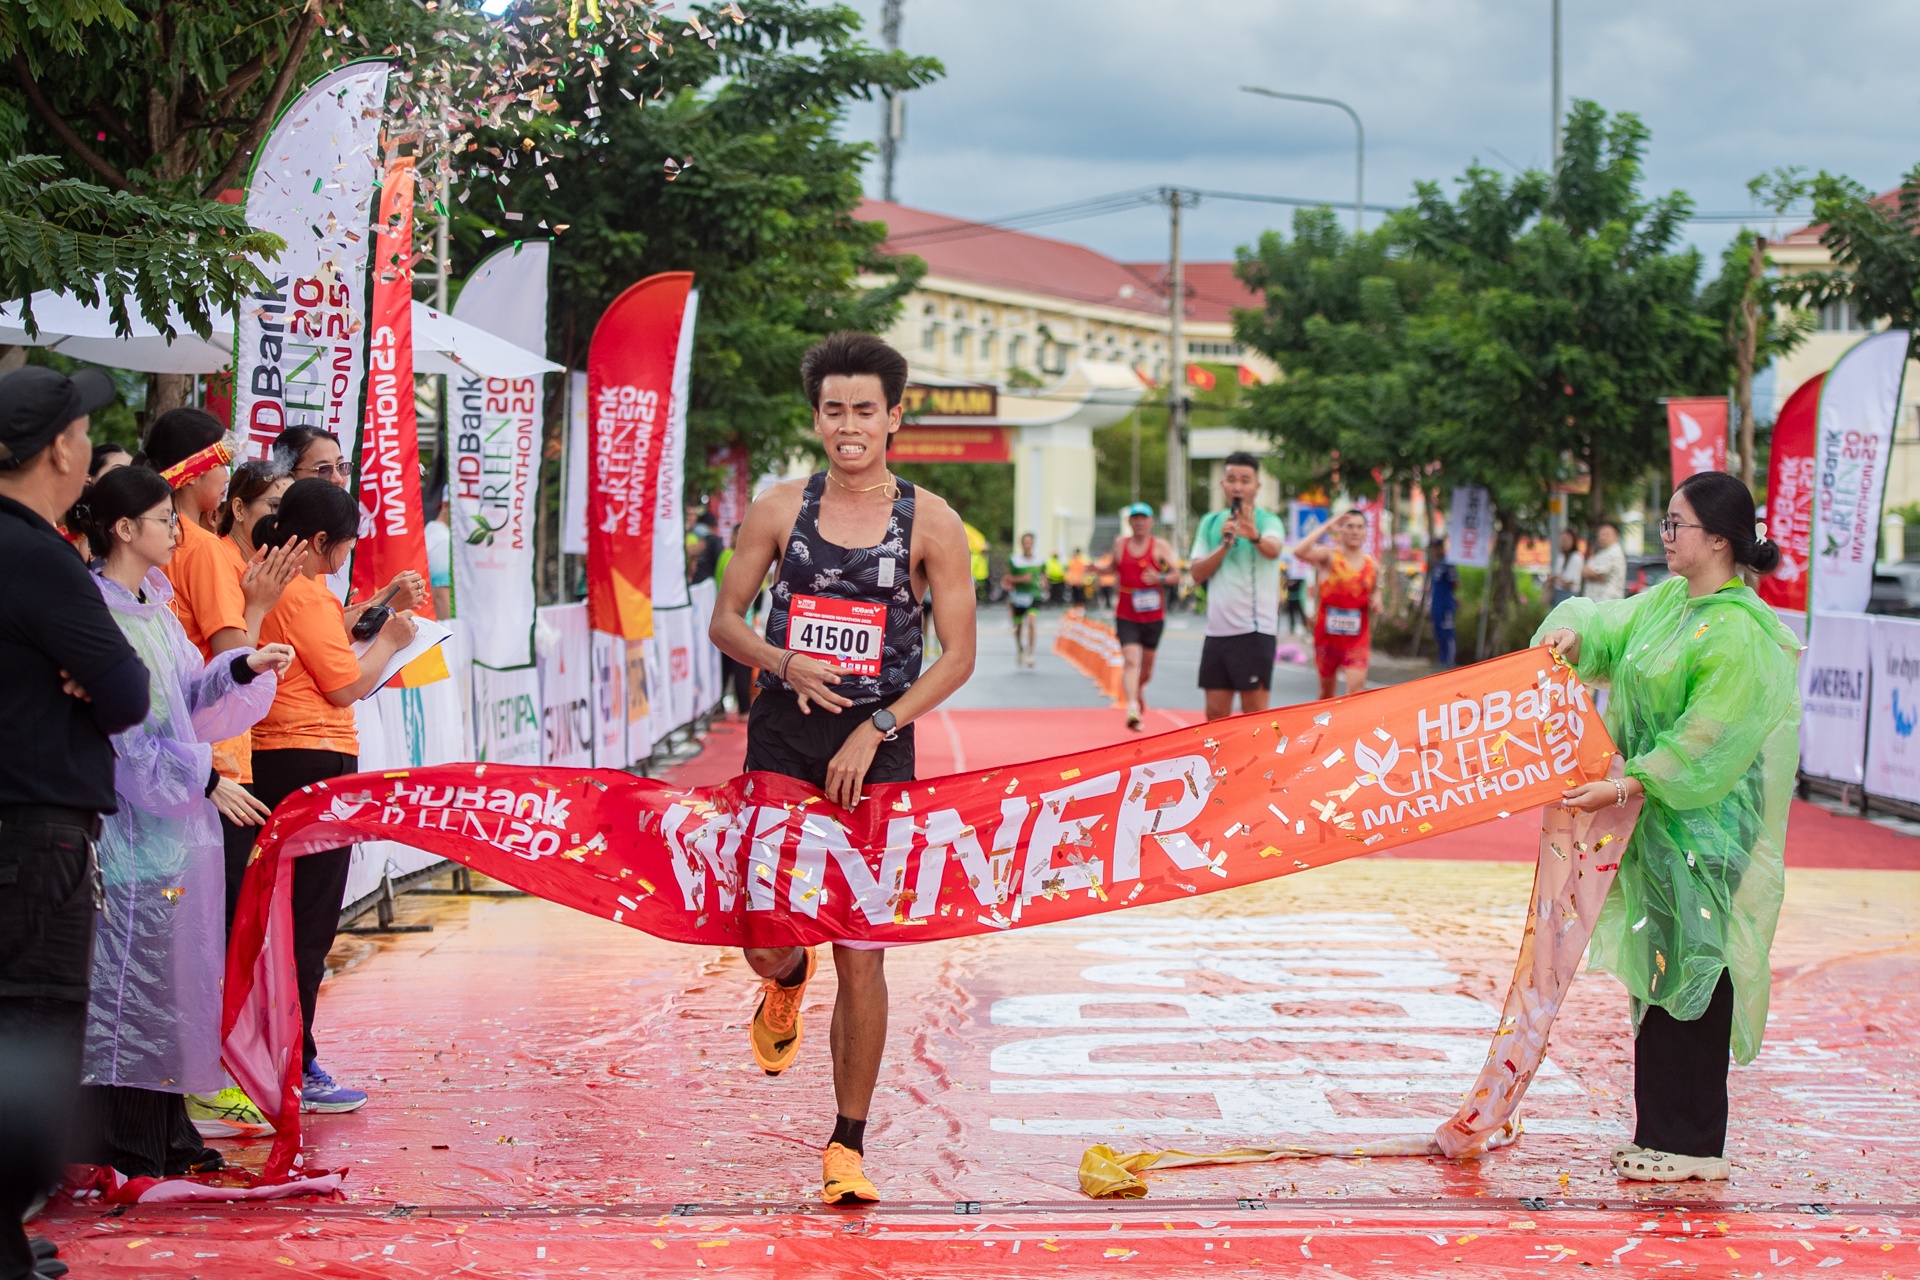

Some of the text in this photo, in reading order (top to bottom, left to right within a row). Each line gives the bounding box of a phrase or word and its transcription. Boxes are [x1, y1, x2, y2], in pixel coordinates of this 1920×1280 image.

[290, 277, 324, 338] 20
[327, 284, 350, 340] 25
[247, 275, 289, 461] HDBank
[617, 384, 637, 421] 20
[370, 325, 409, 536] MARATHON 25
[457, 375, 482, 500] HDBank
[479, 376, 513, 532] GREEN 20
[511, 378, 535, 550] MARATHON 25
[597, 384, 620, 493] HDBank
[626, 389, 659, 537] MARATHON 25
[1797, 457, 1816, 489] 20
[1820, 430, 1843, 523] HDBank
[1842, 431, 1862, 460] 20
[1772, 454, 1800, 548] HDBank
[1850, 434, 1879, 564] MARATHON 25
[800, 623, 870, 654] 41500
[1378, 710, 1585, 798] GREEN 20
[1417, 677, 1589, 747] HDBank
[662, 753, 1215, 927] WINNER
[1361, 760, 1551, 831] MARATHON
